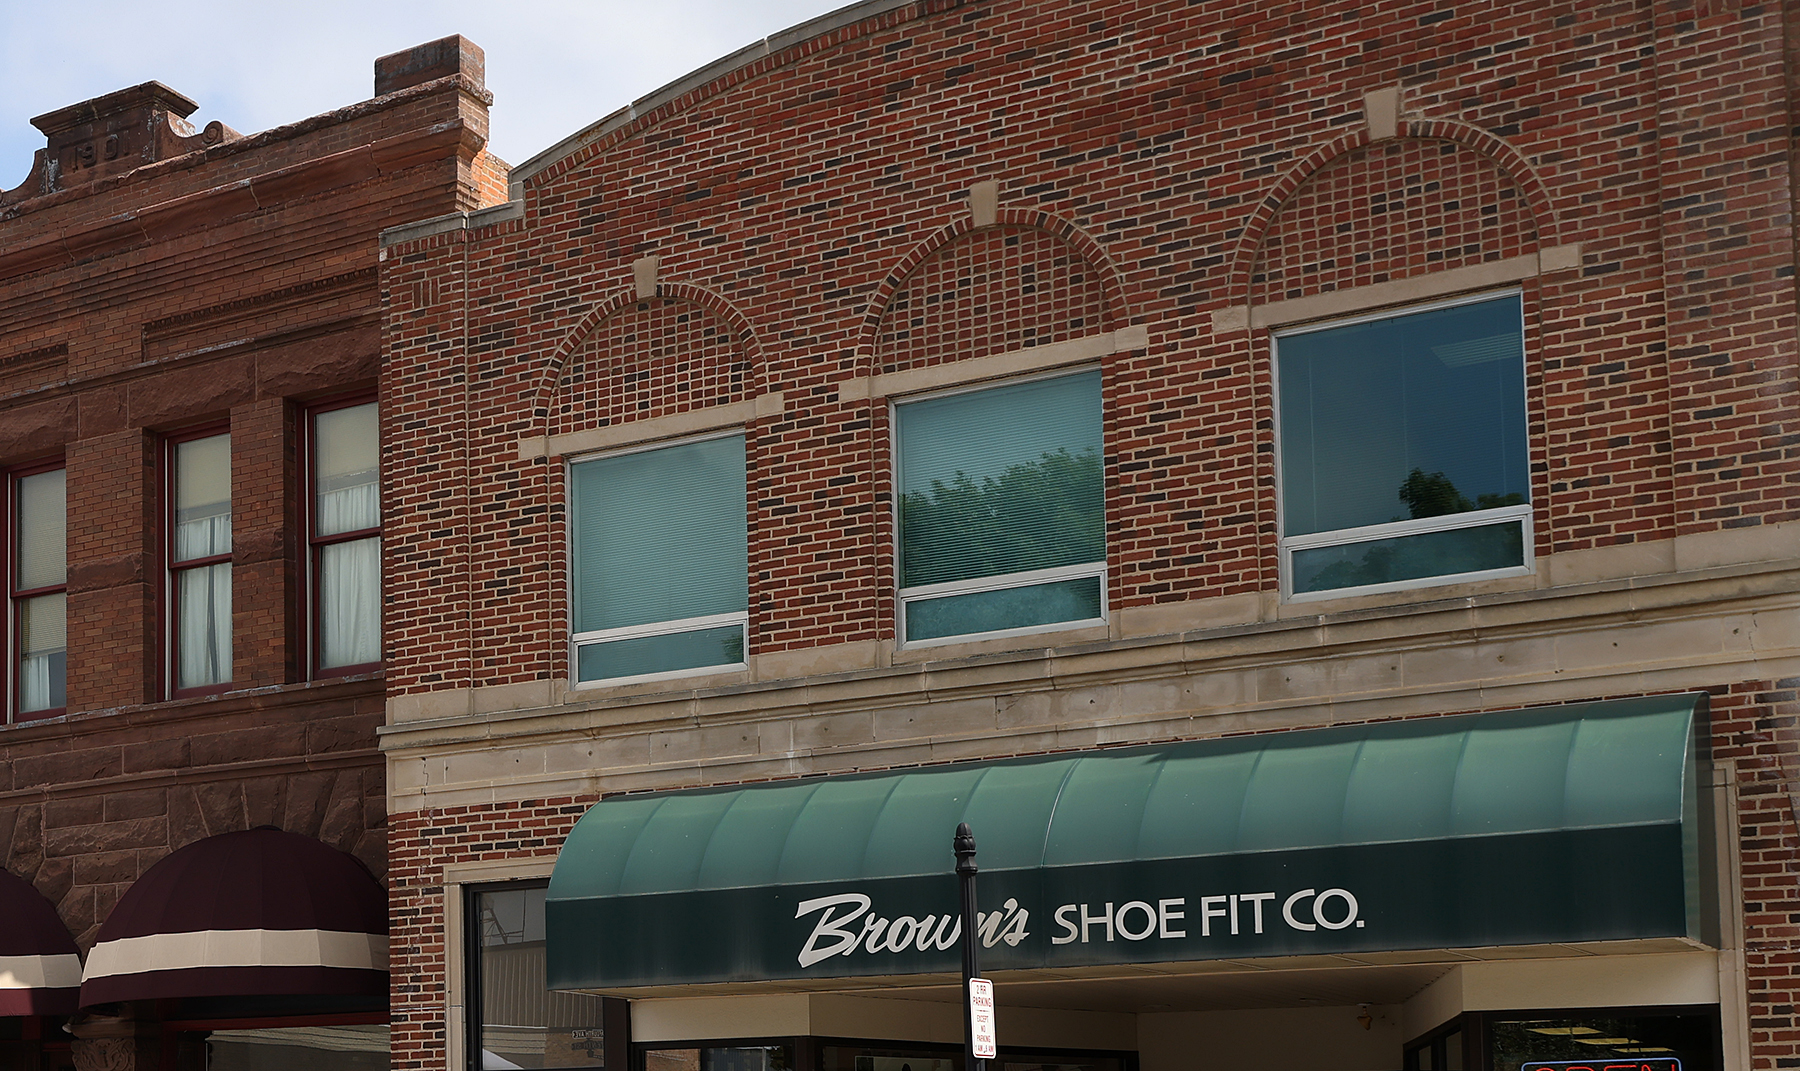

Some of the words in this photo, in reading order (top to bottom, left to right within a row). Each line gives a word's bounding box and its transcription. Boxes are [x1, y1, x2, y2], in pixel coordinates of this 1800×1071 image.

[795, 892, 1031, 969] Brown's
[1050, 896, 1187, 946] SHOE
[1201, 891, 1276, 938] FIT
[1281, 888, 1366, 933] CO.
[972, 996, 992, 1008] PARKING
[976, 1034, 991, 1043] PARKING
